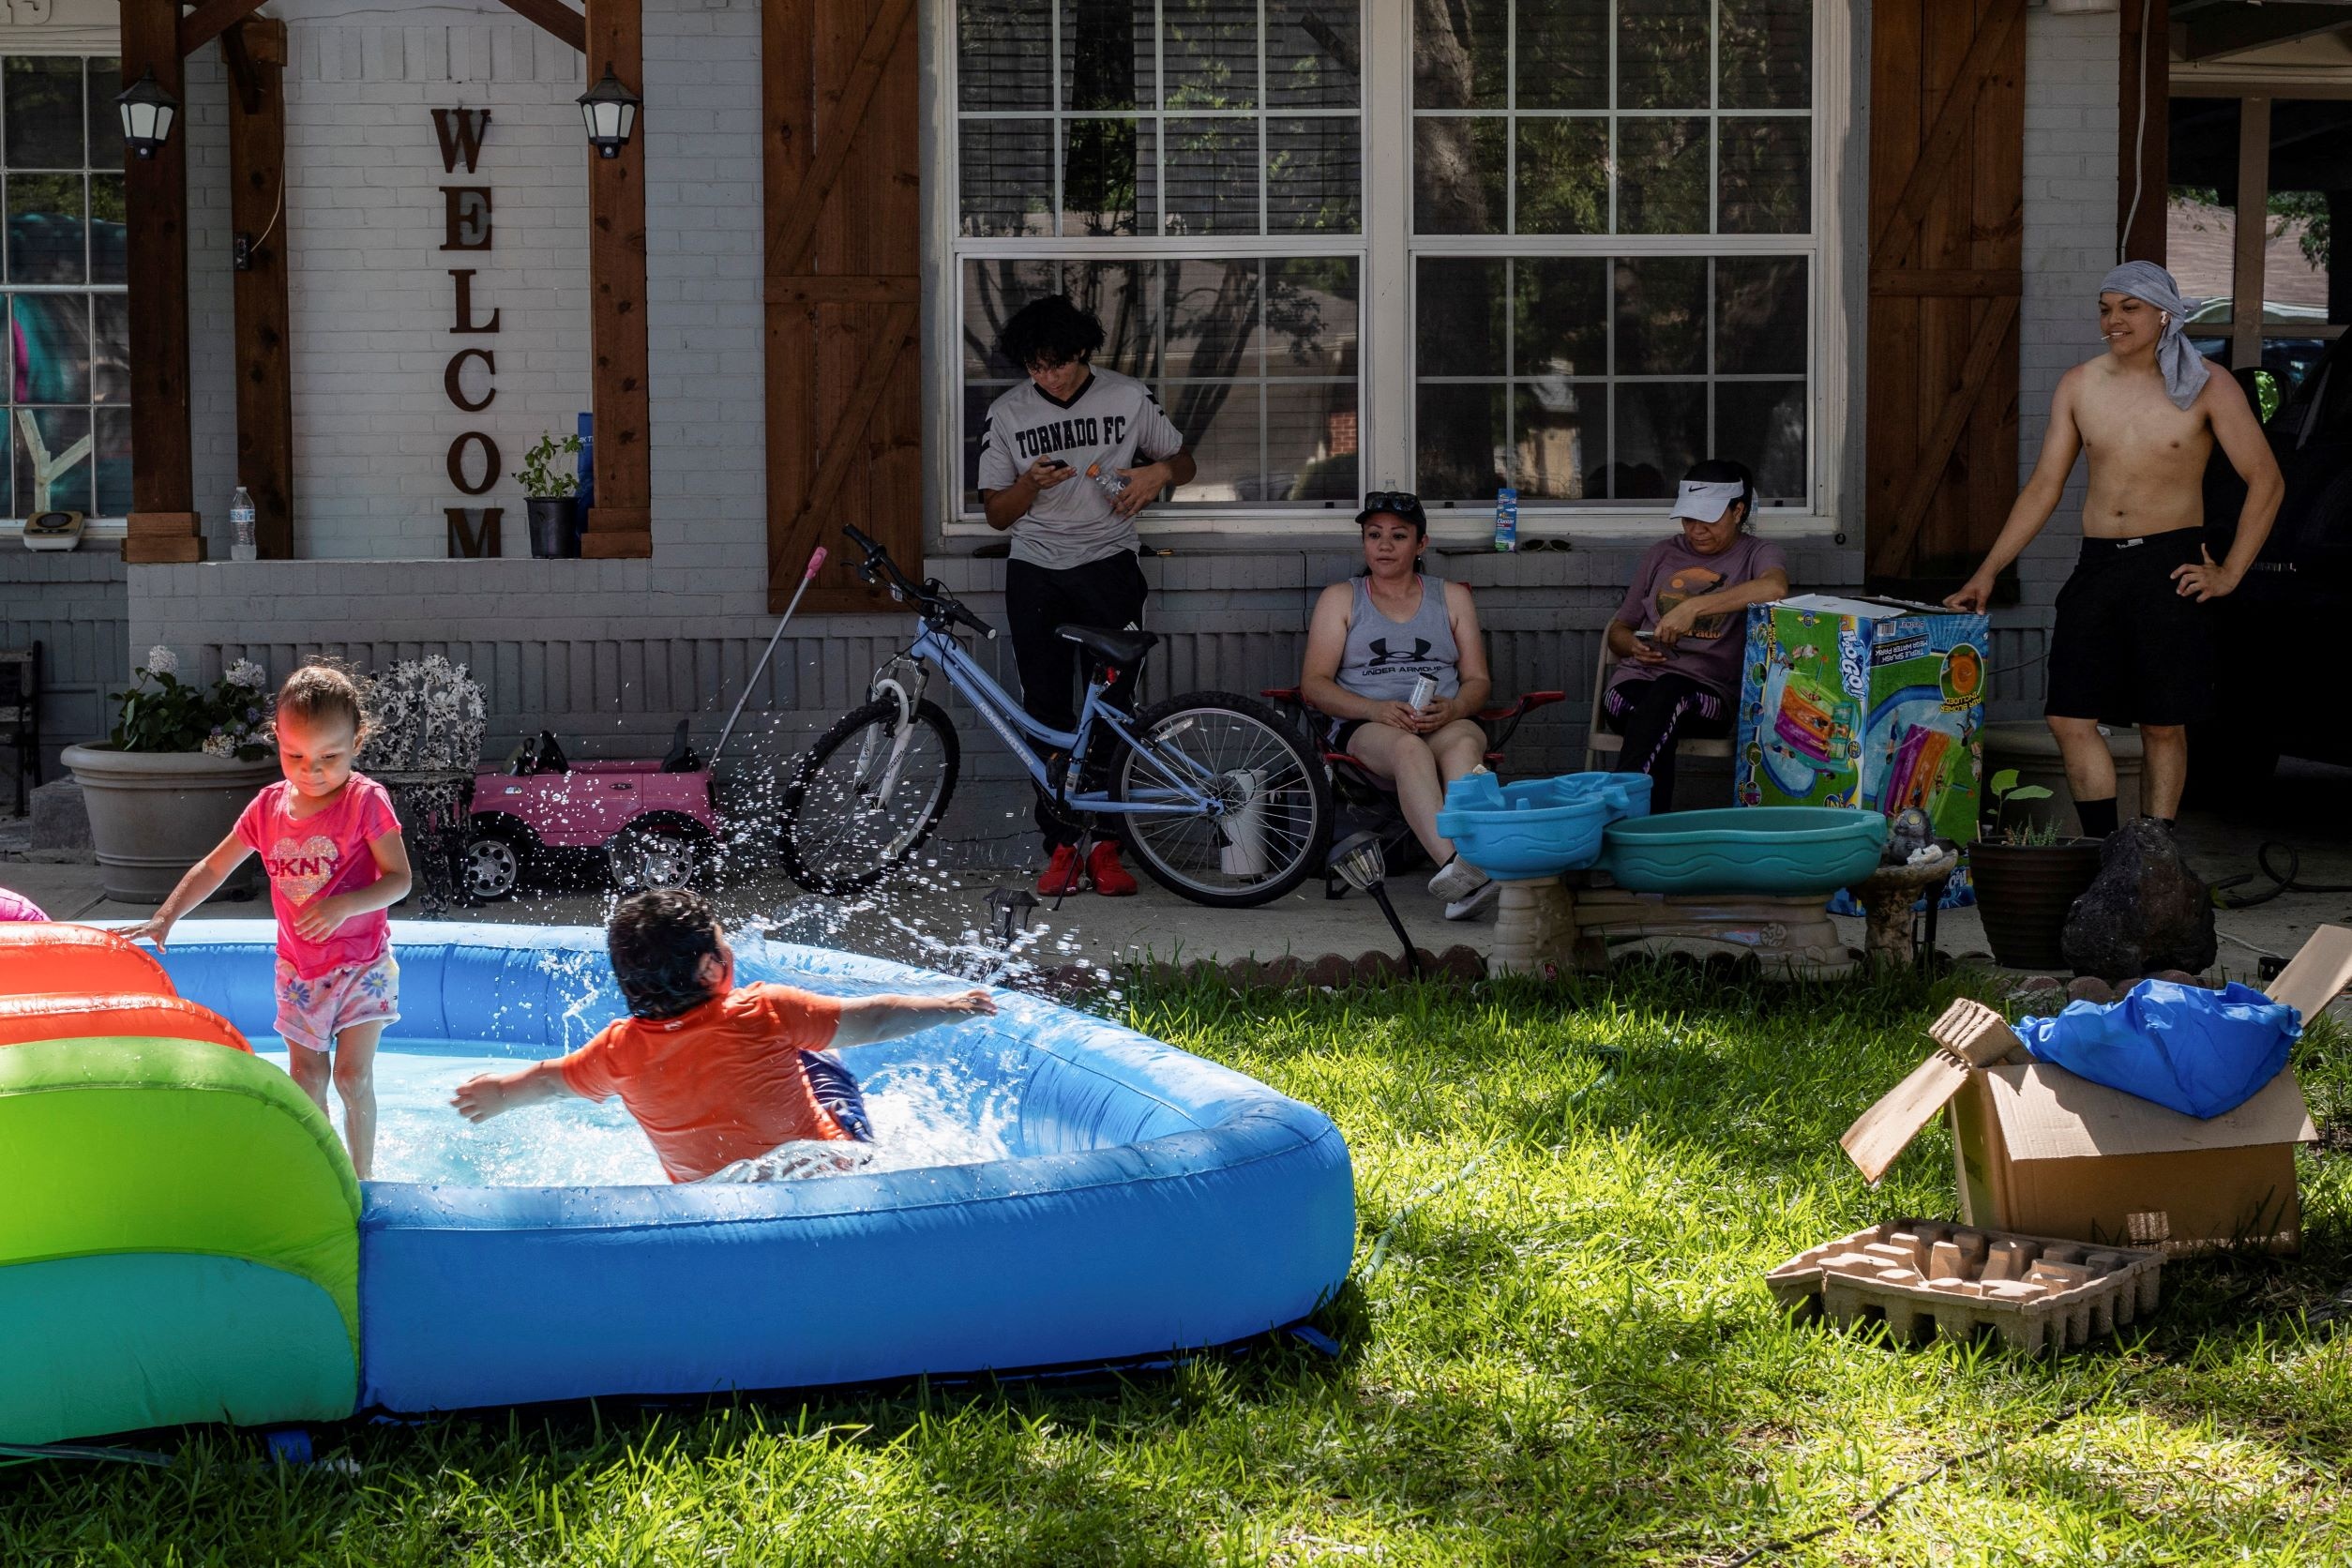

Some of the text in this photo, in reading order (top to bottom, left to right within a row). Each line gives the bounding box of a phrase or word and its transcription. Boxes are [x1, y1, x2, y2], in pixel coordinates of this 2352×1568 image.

[1015, 415, 1125, 459] TORNADO FC
[1875, 648, 1892, 656] PARK
[1892, 643, 1912, 653] WATER
[1881, 649, 1924, 663] TRIPLE SPLASH
[1362, 667, 1396, 676] UNDER
[1944, 691, 1978, 704] INCLUDED
[1939, 697, 1982, 713] AIR BLOWER
[978, 702, 1033, 767] ROADMASTER
[264, 856, 341, 877] DKNY
